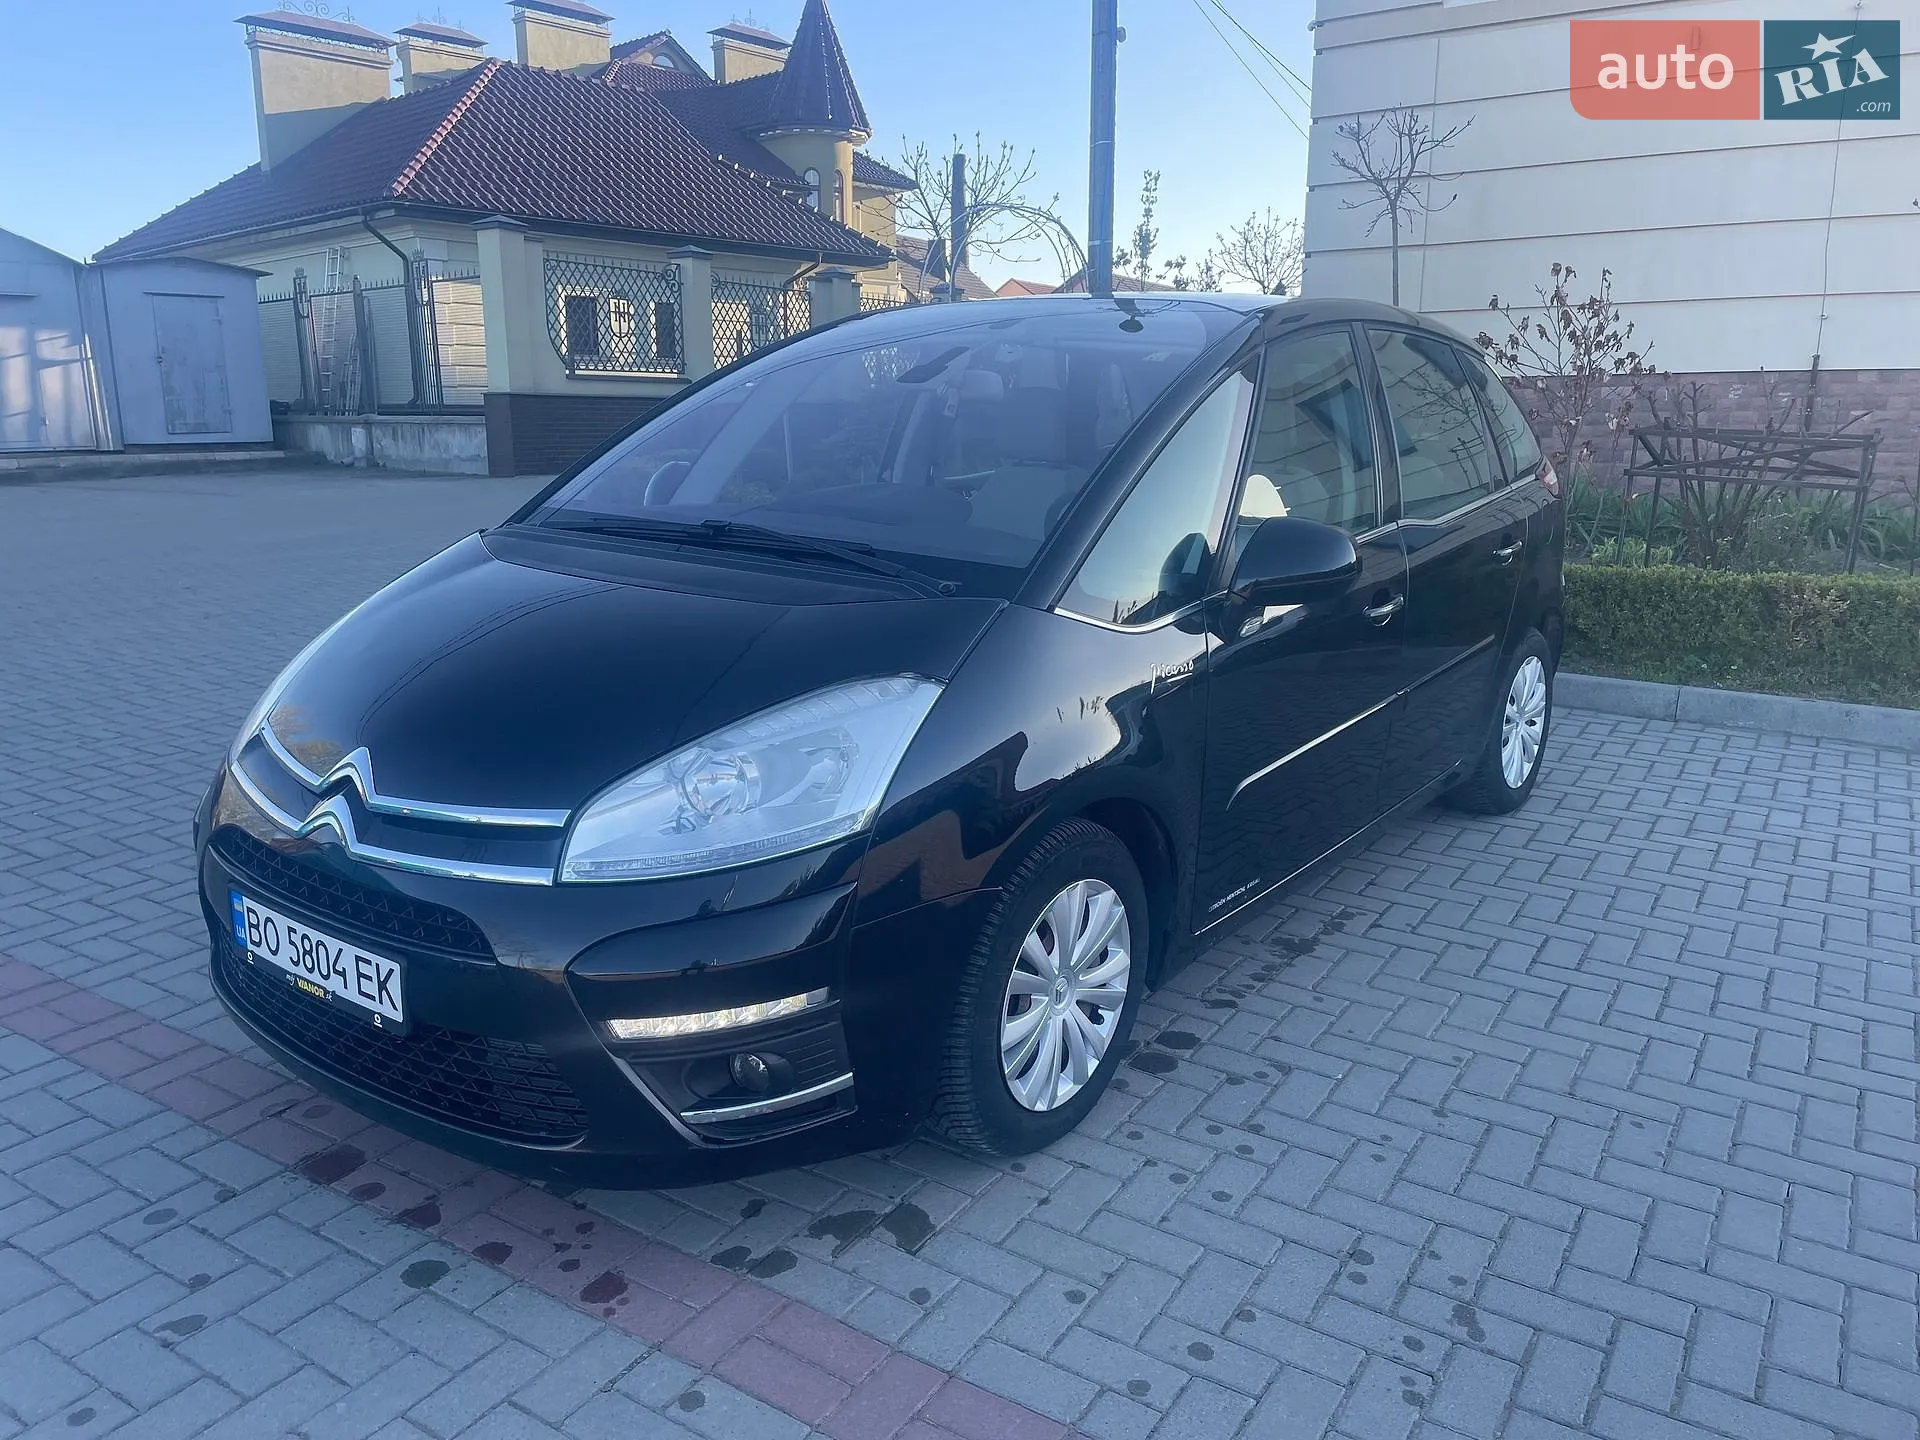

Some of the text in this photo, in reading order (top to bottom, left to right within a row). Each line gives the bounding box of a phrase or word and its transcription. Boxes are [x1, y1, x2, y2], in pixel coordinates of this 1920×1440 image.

[236, 925, 247, 941] UA
[246, 905, 399, 1012] BO 5804 EK
